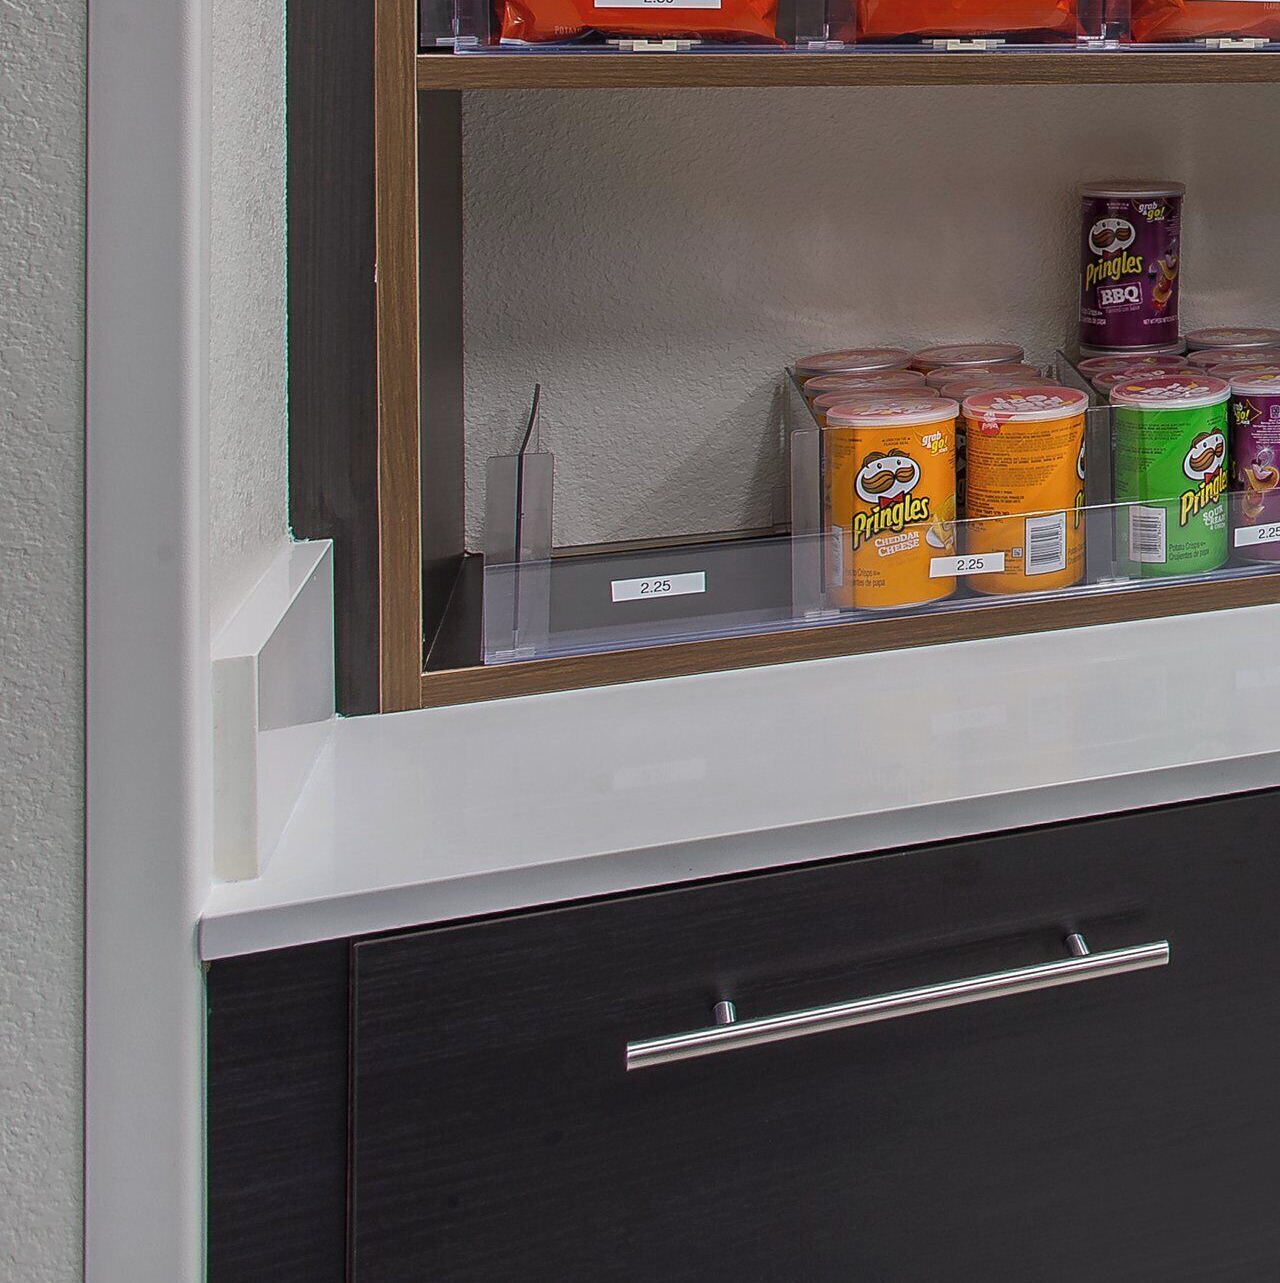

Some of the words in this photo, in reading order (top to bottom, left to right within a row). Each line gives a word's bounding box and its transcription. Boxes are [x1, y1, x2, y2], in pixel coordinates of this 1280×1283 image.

[1085, 251, 1144, 292] Pringles
[1100, 286, 1140, 306] BBQ
[921, 431, 943, 447] grab
[931, 435, 949, 454] go!
[852, 494, 930, 551] Pringles
[874, 531, 920, 548] CHEDDAR
[878, 538, 920, 558] CHEESE
[957, 558, 985, 571] 2.25
[640, 579, 671, 594] 2.25
